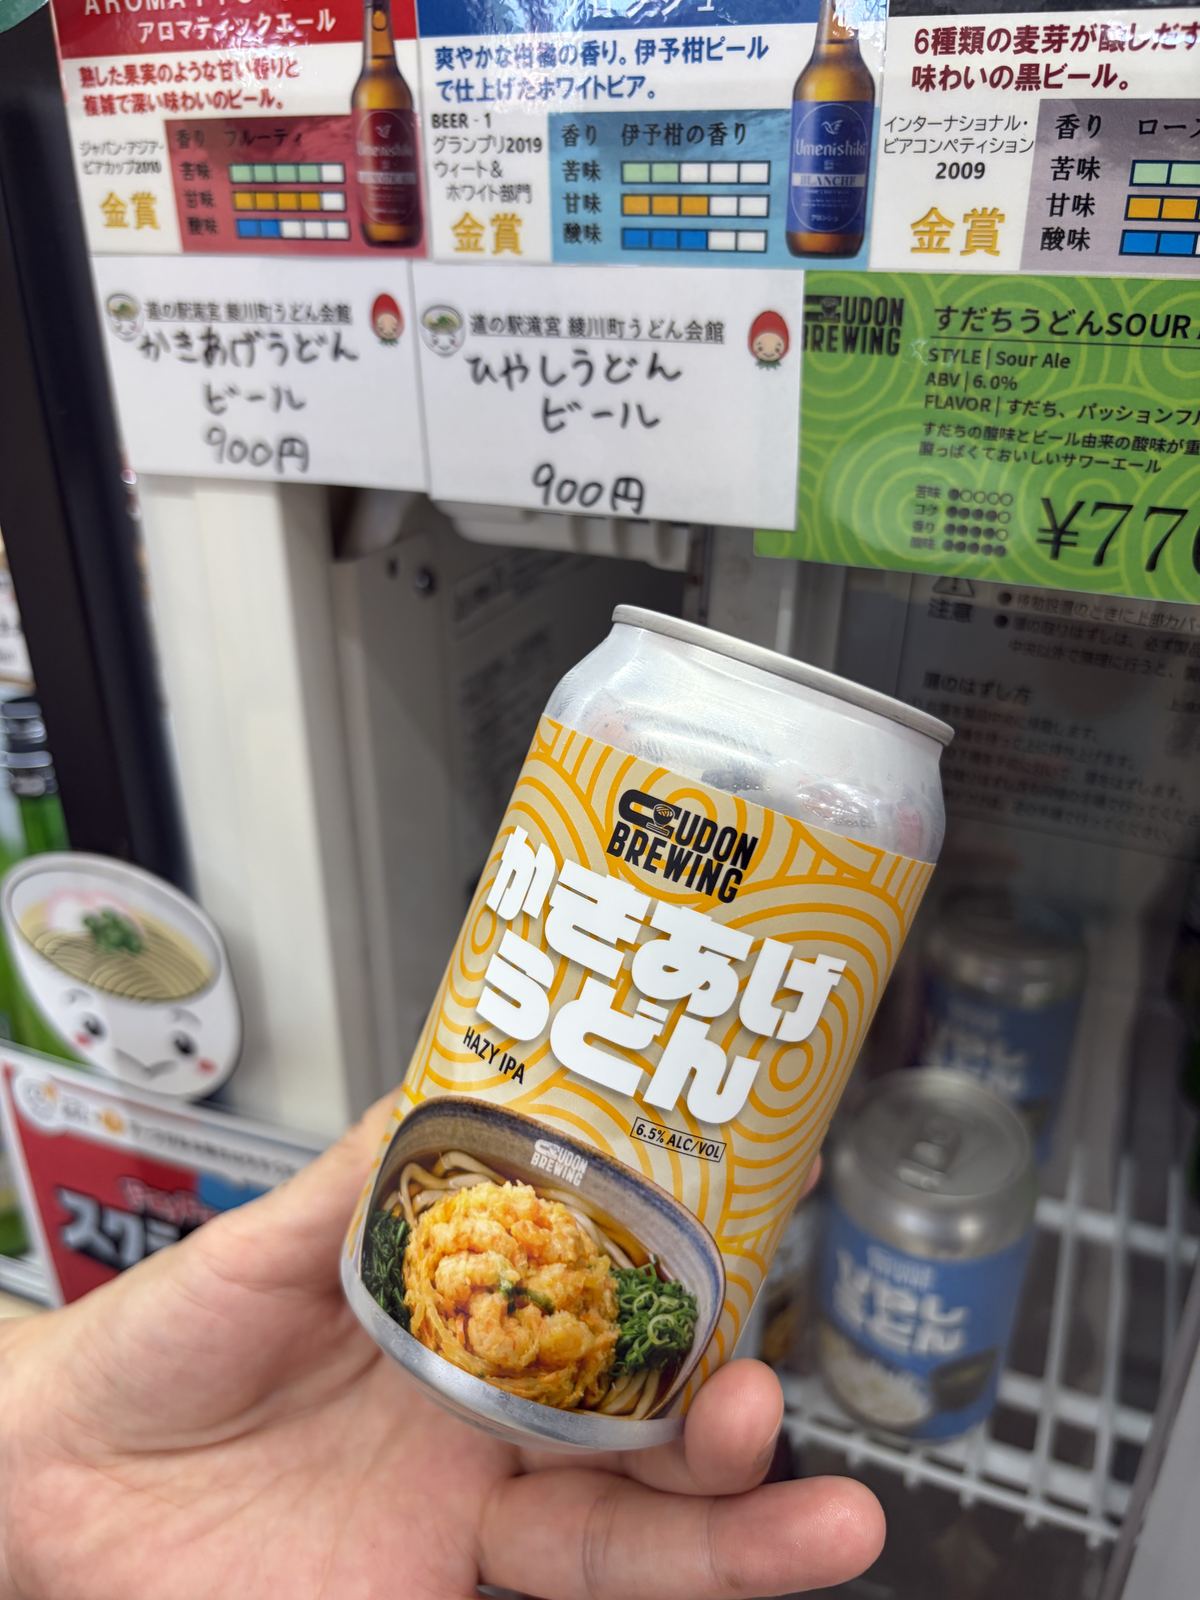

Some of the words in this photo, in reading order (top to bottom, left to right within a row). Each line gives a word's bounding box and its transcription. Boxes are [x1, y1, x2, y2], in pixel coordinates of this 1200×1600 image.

[138, 8, 336, 44] アロマティックエール
[79, 56, 300, 89] 熟した果実のような甘い香りと
[912, 63, 1128, 92] 味わいの黒ビール。
[436, 75, 656, 102] で仕上げたホワイトビア。
[83, 88, 284, 117] 複雑で深い味わいのビール。
[431, 113, 468, 129] BEER
[561, 124, 597, 147] 香り
[621, 121, 748, 147] 伊予柑の香り
[884, 114, 1028, 133] インターナショナル・
[1055, 113, 1101, 140] 香り
[176, 129, 205, 148] 香り
[433, 135, 542, 154] グランプリ2019
[795, 139, 866, 156] Umenishiki
[884, 138, 1034, 154] ビアコンペティション
[179, 161, 210, 181] 苦味
[561, 160, 601, 182] 苦味
[935, 162, 986, 179] 2009
[1051, 156, 1100, 182] 苦味
[183, 190, 214, 208] 甘味
[447, 183, 533, 204] ホワイト部門
[562, 193, 602, 214] 甘味
[1046, 194, 1096, 218] 甘味
[100, 191, 160, 230] 金賞
[452, 212, 523, 255] 金賞
[562, 223, 602, 244] 酸味
[910, 206, 1005, 256] 金賞
[1040, 227, 1091, 251] 酸味
[842, 296, 904, 327] UDON
[137, 328, 358, 367] かきあげうどん
[928, 348, 981, 365] STYLE
[996, 351, 1037, 368] Sour
[1042, 353, 1071, 369] Ale
[465, 349, 681, 391] ひやしうどん
[925, 372, 961, 388] ABV
[973, 374, 1018, 391] 6.0%
[205, 383, 306, 416] ビール
[924, 395, 991, 412] FLAVOR
[542, 397, 660, 433] ビール
[204, 424, 310, 474] 900円
[532, 462, 645, 514] 900円
[1036, 498, 1200, 575] ¥77
[606, 821, 743, 903] BREWING
[486, 825, 847, 1042] かきあげ
[476, 929, 760, 1124] うどん
[463, 1026, 501, 1064] HAZY
[499, 1052, 525, 1085] IPA
[636, 1123, 665, 1143] 6.5%
[666, 1134, 720, 1158] ALC/VOL
[530, 1151, 583, 1187] BREWING
